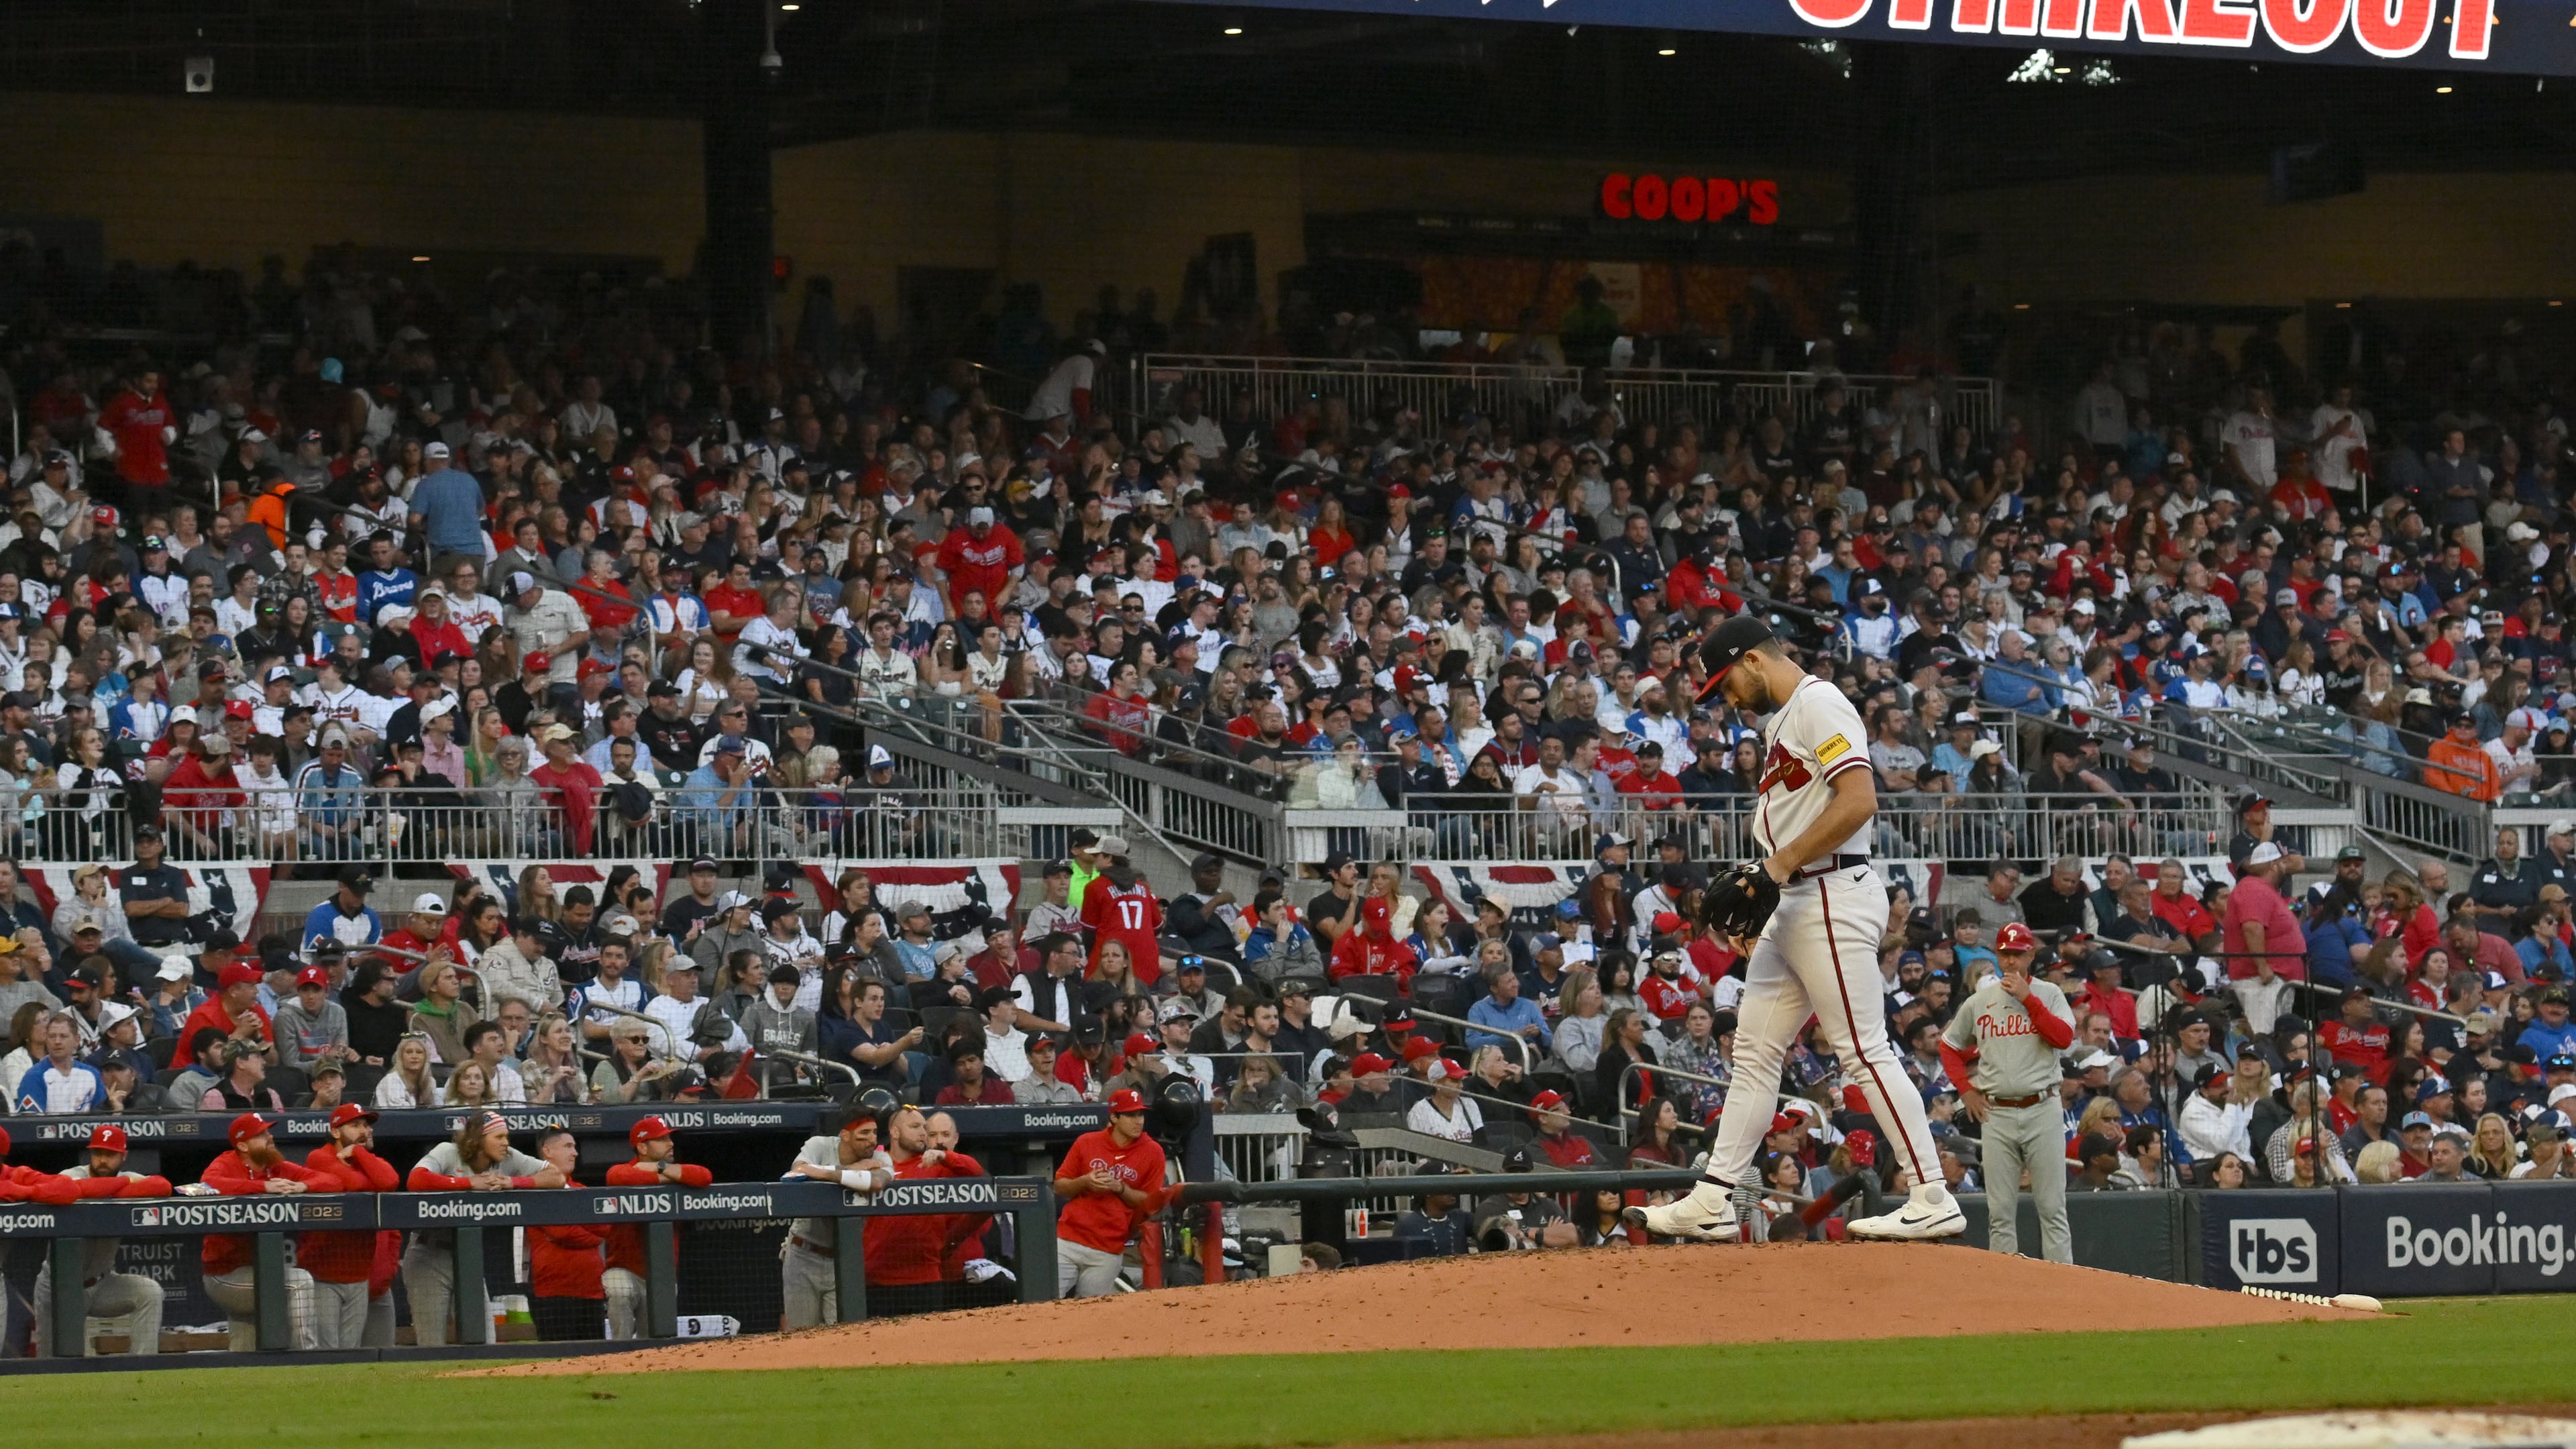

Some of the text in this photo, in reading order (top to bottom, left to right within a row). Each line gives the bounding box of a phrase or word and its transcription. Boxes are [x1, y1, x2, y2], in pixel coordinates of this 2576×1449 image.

[1602, 173, 1780, 225] COOP'S
[1818, 739, 1845, 758] QUIKRETE
[1118, 900, 1143, 930] 17
[2007, 929, 2017, 942] P
[307, 968, 317, 979] P
[1976, 1014, 2039, 1040] Phillie
[763, 1028, 802, 1046] BRAVES
[1130, 1091, 1138, 1102] P
[58, 1120, 199, 1138] POSTASON 2023
[287, 1119, 331, 1134] Bookin
[572, 1114, 602, 1126] 2023
[663, 1112, 782, 1128] NLDS Booking.com
[1024, 1112, 1098, 1128] Booking.com
[103, 1130, 113, 1142] P
[620, 1194, 671, 1214] NLDS
[871, 1183, 1038, 1208] POSTSEASON 2023
[162, 1203, 343, 1226] POSTSEASON 2023
[418, 1199, 521, 1220] Booking.com
[119, 1242, 184, 1260] TRUIST
[2238, 1228, 2310, 1274] tbs
[2387, 1210, 2575, 1277] Booking.
[129, 1264, 176, 1282] PARK
